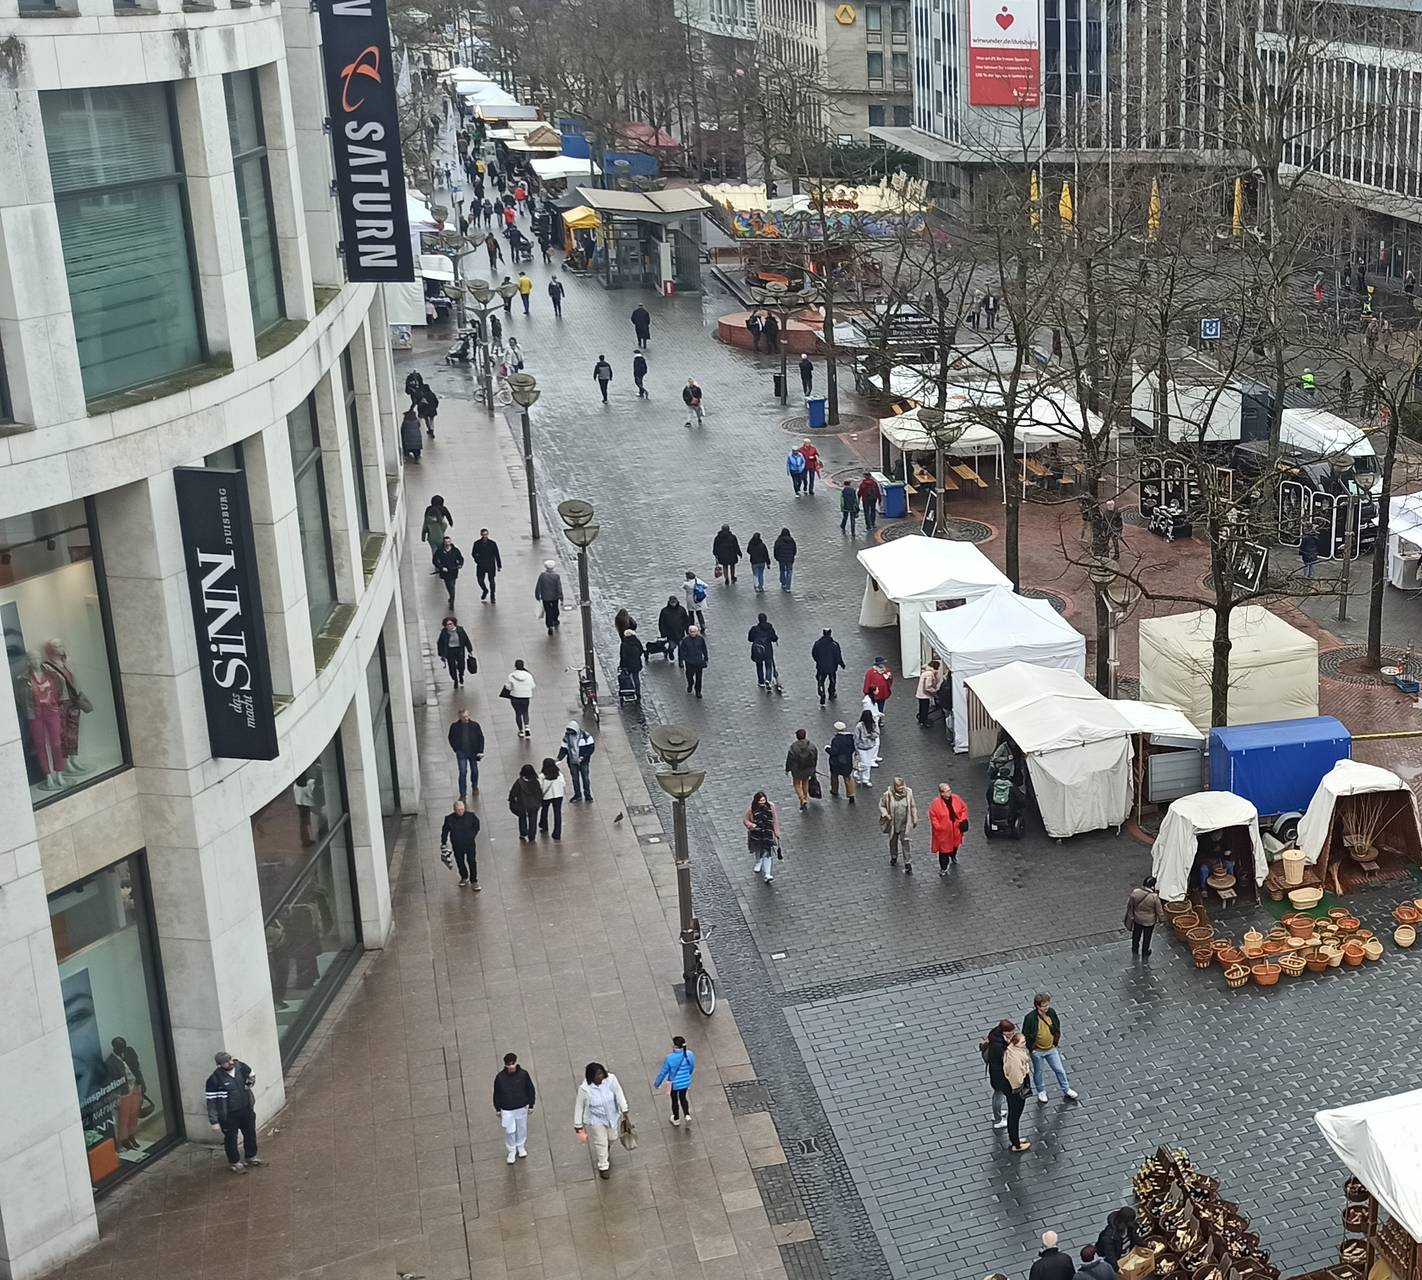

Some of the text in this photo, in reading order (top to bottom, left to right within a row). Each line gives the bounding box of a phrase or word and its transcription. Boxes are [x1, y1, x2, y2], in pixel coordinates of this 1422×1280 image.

[345, 120, 398, 268] SATURN
[197, 487, 252, 691] SiNN DUISBURG
[228, 692, 243, 714] das
[246, 694, 256, 729] macht
